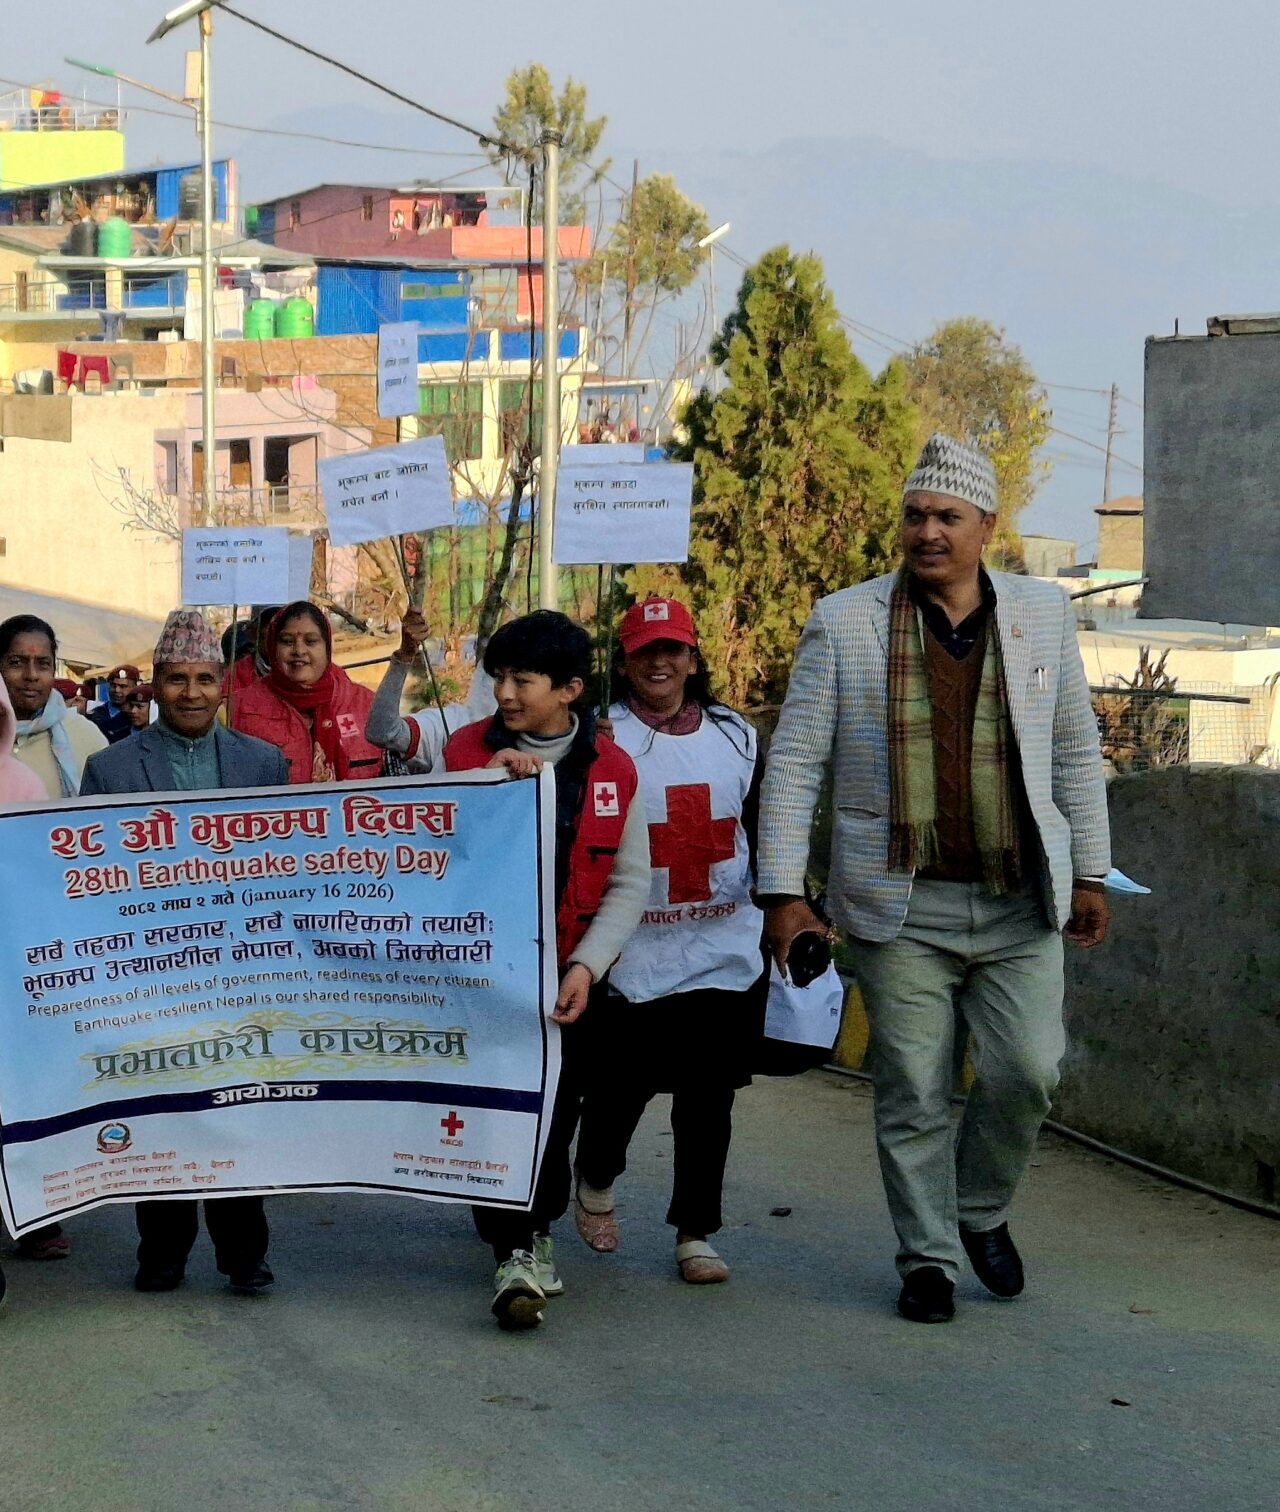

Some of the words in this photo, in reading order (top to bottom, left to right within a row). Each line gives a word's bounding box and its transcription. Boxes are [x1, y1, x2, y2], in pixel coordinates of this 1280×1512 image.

[50, 823, 104, 857] २८
[342, 796, 457, 837] दिवस
[65, 864, 130, 898] 28th
[138, 851, 297, 889] Earthquake
[304, 846, 389, 879] safety
[395, 845, 450, 879] Day
[119, 902, 156, 916] २०८२
[161, 897, 191, 911] माघ
[196, 896, 205, 907] २
[241, 886, 316, 907] (january
[323, 883, 340, 898] 16
[347, 883, 394, 902] 2026)
[73, 931, 135, 958] तहका
[22, 966, 96, 1000] भूकम्प
[27, 993, 122, 1017] Preparedness
[126, 988, 140, 1000] of
[143, 985, 158, 998] all
[162, 979, 200, 995] levels
[204, 974, 219, 987] of
[222, 969, 313, 987] government,
[317, 968, 381, 982] readiness
[385, 971, 401, 982] of
[403, 974, 440, 986] every
[216, 992, 258, 1008] Nepal
[261, 993, 272, 1004] is
[275, 992, 299, 1003] our
[303, 989, 349, 1002] shared
[353, 990, 445, 1008] responsibility
[91, 1025, 274, 1082] प्रभातफेरी
[299, 1022, 469, 1060] कार्यक्रम
[212, 1083, 319, 1105] आयोजक
